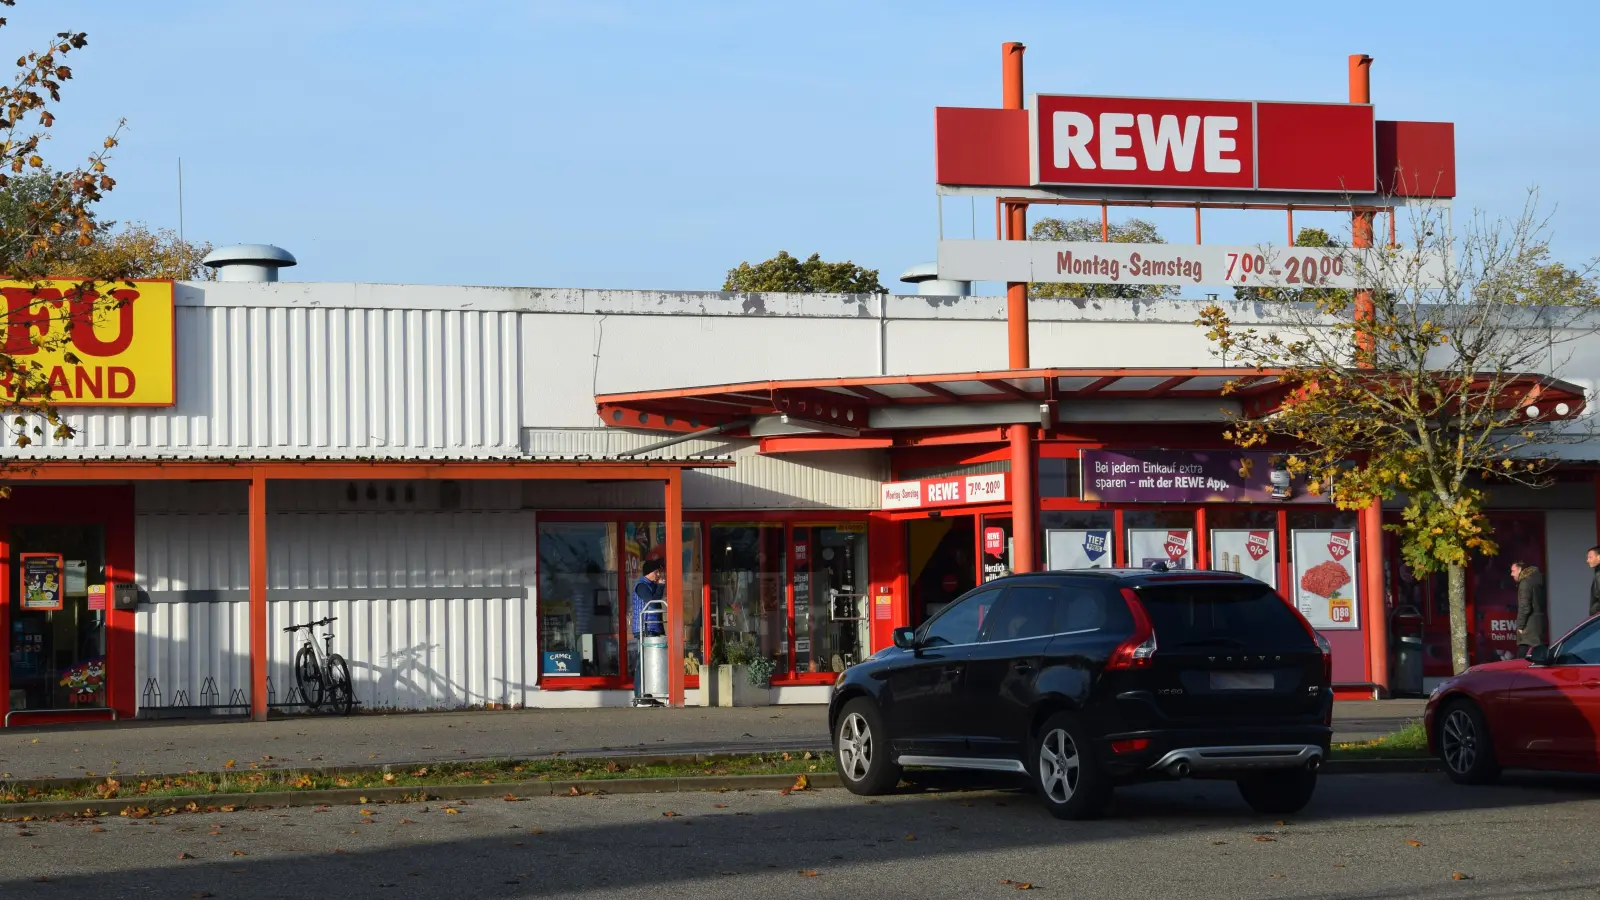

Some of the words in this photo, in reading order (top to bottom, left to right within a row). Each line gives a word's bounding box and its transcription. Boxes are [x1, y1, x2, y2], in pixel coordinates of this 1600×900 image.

[1053, 111, 1241, 174] REWE
[0, 287, 140, 357] FU
[1095, 462, 1109, 473] Bei
[1111, 462, 1140, 475] jedem
[1143, 462, 1176, 473] Einkauf
[1179, 464, 1203, 474] extra
[1095, 478, 1127, 490] sparen
[1138, 477, 1155, 488] mit
[1157, 477, 1173, 488] der
[1175, 477, 1204, 488] REWE
[1206, 477, 1230, 491] App.
[928, 481, 959, 502] REWE
[1087, 534, 1104, 546] TIEF
[984, 563, 1005, 573] Herzlich
[1491, 620, 1517, 631] REW
[1491, 632, 1505, 641] Dein
[1208, 655, 1282, 663] VOLVO
